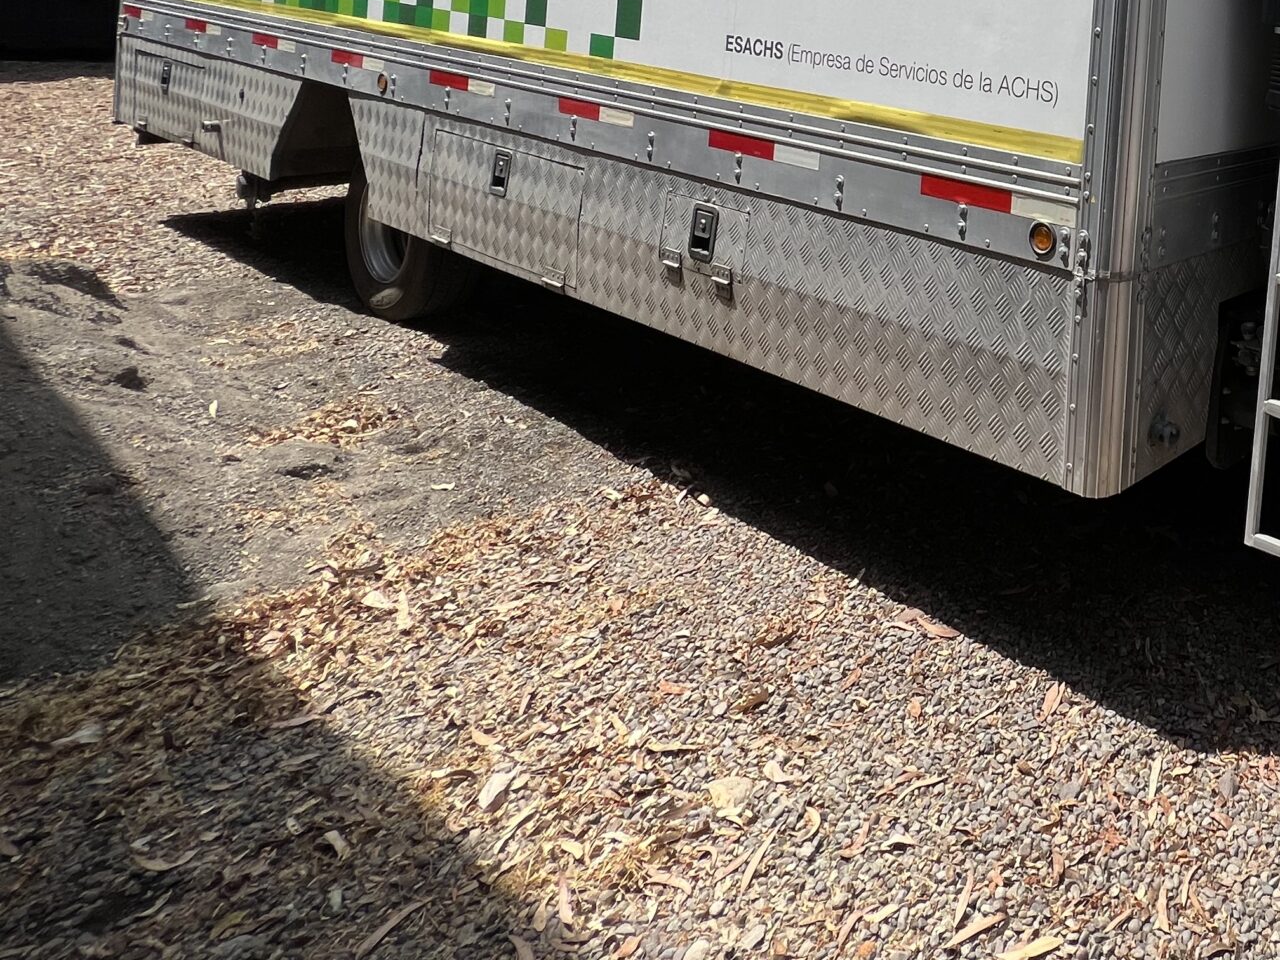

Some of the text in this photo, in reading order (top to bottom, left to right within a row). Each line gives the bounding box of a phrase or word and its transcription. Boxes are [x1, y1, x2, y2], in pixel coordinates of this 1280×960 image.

[725, 35, 1059, 109] ESACHS (Empresa de Servicios de la ACHS)
